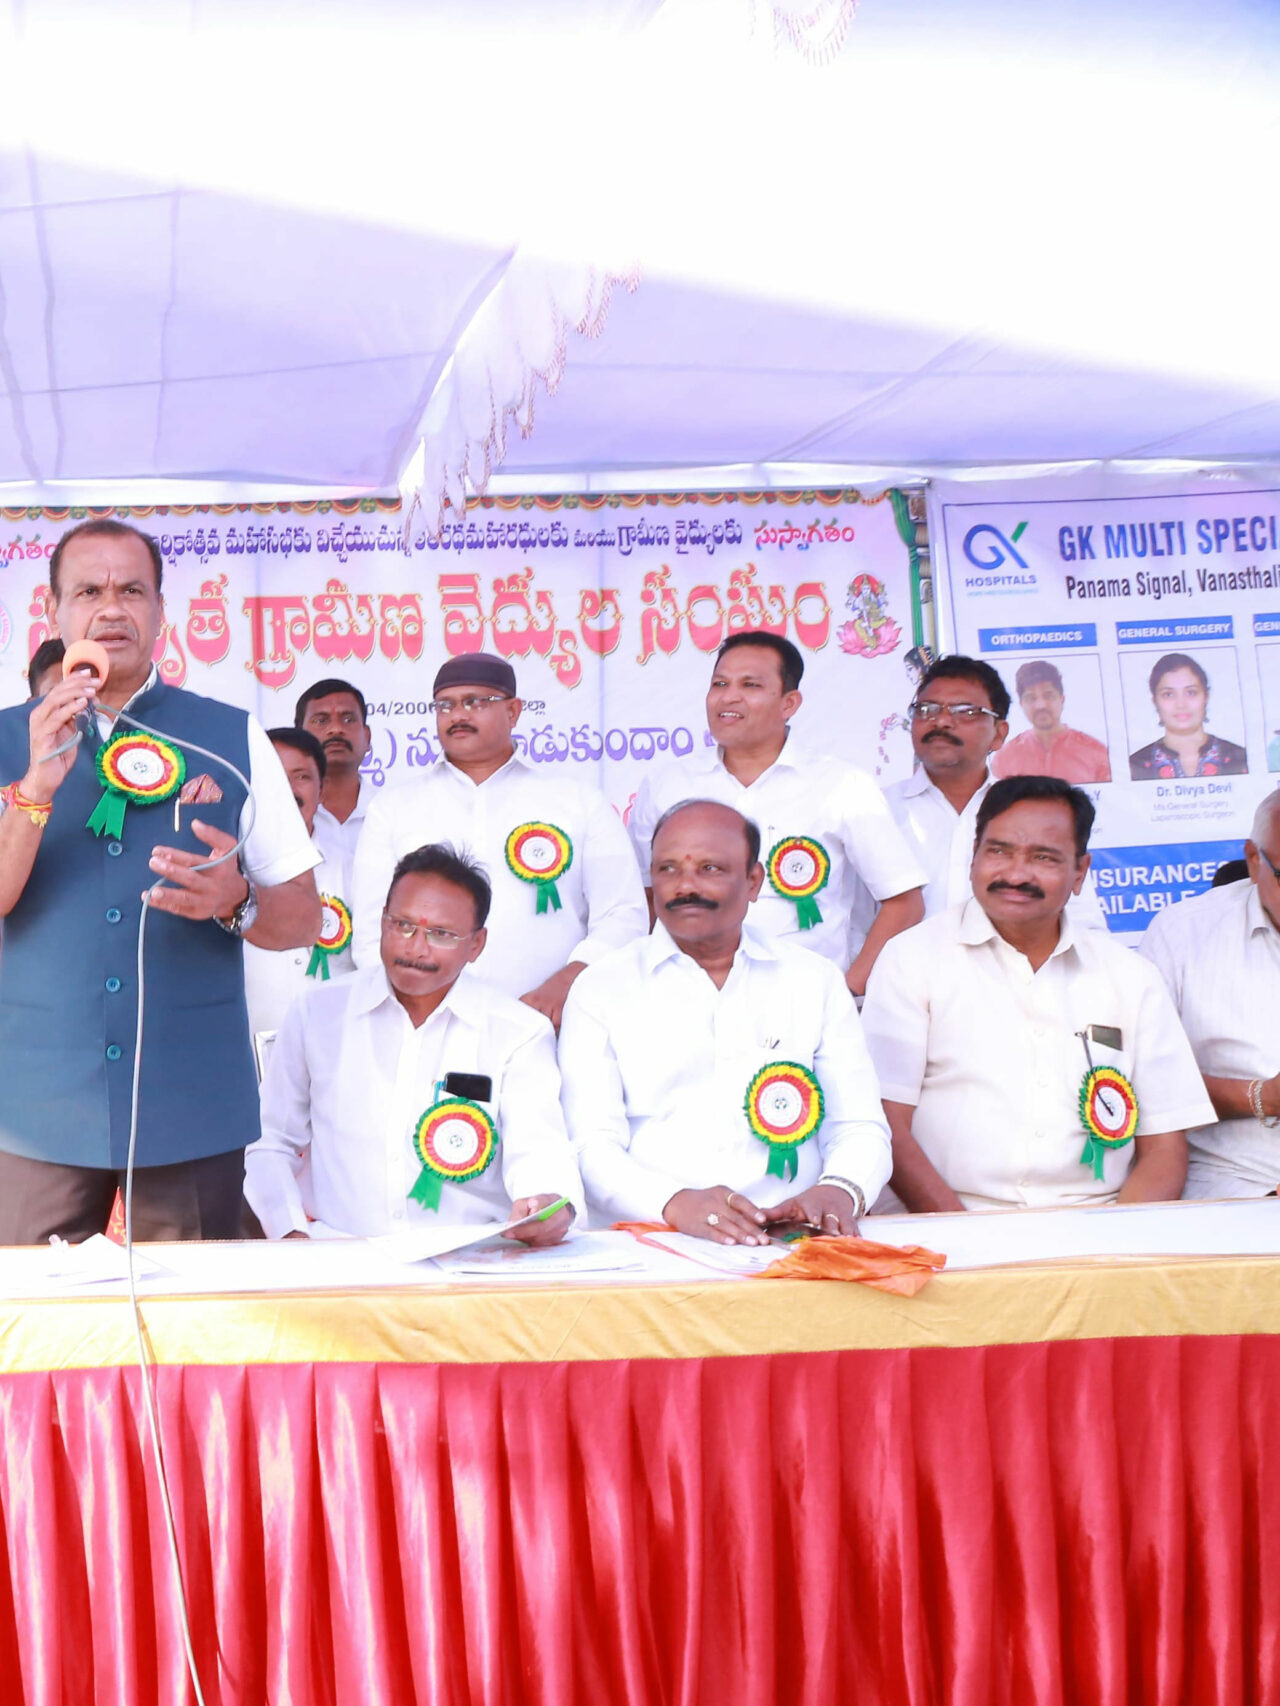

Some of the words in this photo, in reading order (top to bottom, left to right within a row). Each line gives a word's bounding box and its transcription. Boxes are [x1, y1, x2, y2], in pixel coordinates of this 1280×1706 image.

[225, 525, 312, 559] మహాసభకు
[616, 516, 670, 557] గ్రామీణ
[675, 518, 743, 556] వైద్యులకు
[753, 517, 856, 551] సుస్వాగతం
[1058, 525, 1096, 561] GK
[1103, 521, 1187, 559] MULTI
[965, 574, 1037, 588] HOSPITALS
[1065, 574, 1131, 599] Panama
[1136, 569, 1193, 600] Signal,
[242, 577, 425, 691] గ్రామీణ
[635, 562, 831, 666] సంఘం
[991, 630, 1083, 647] ORTHOPAEDICS
[1118, 625, 1173, 640] GENERAL
[1174, 622, 1231, 636] SURGERY
[1175, 783, 1205, 798] Divya
[1207, 781, 1232, 795] Devi
